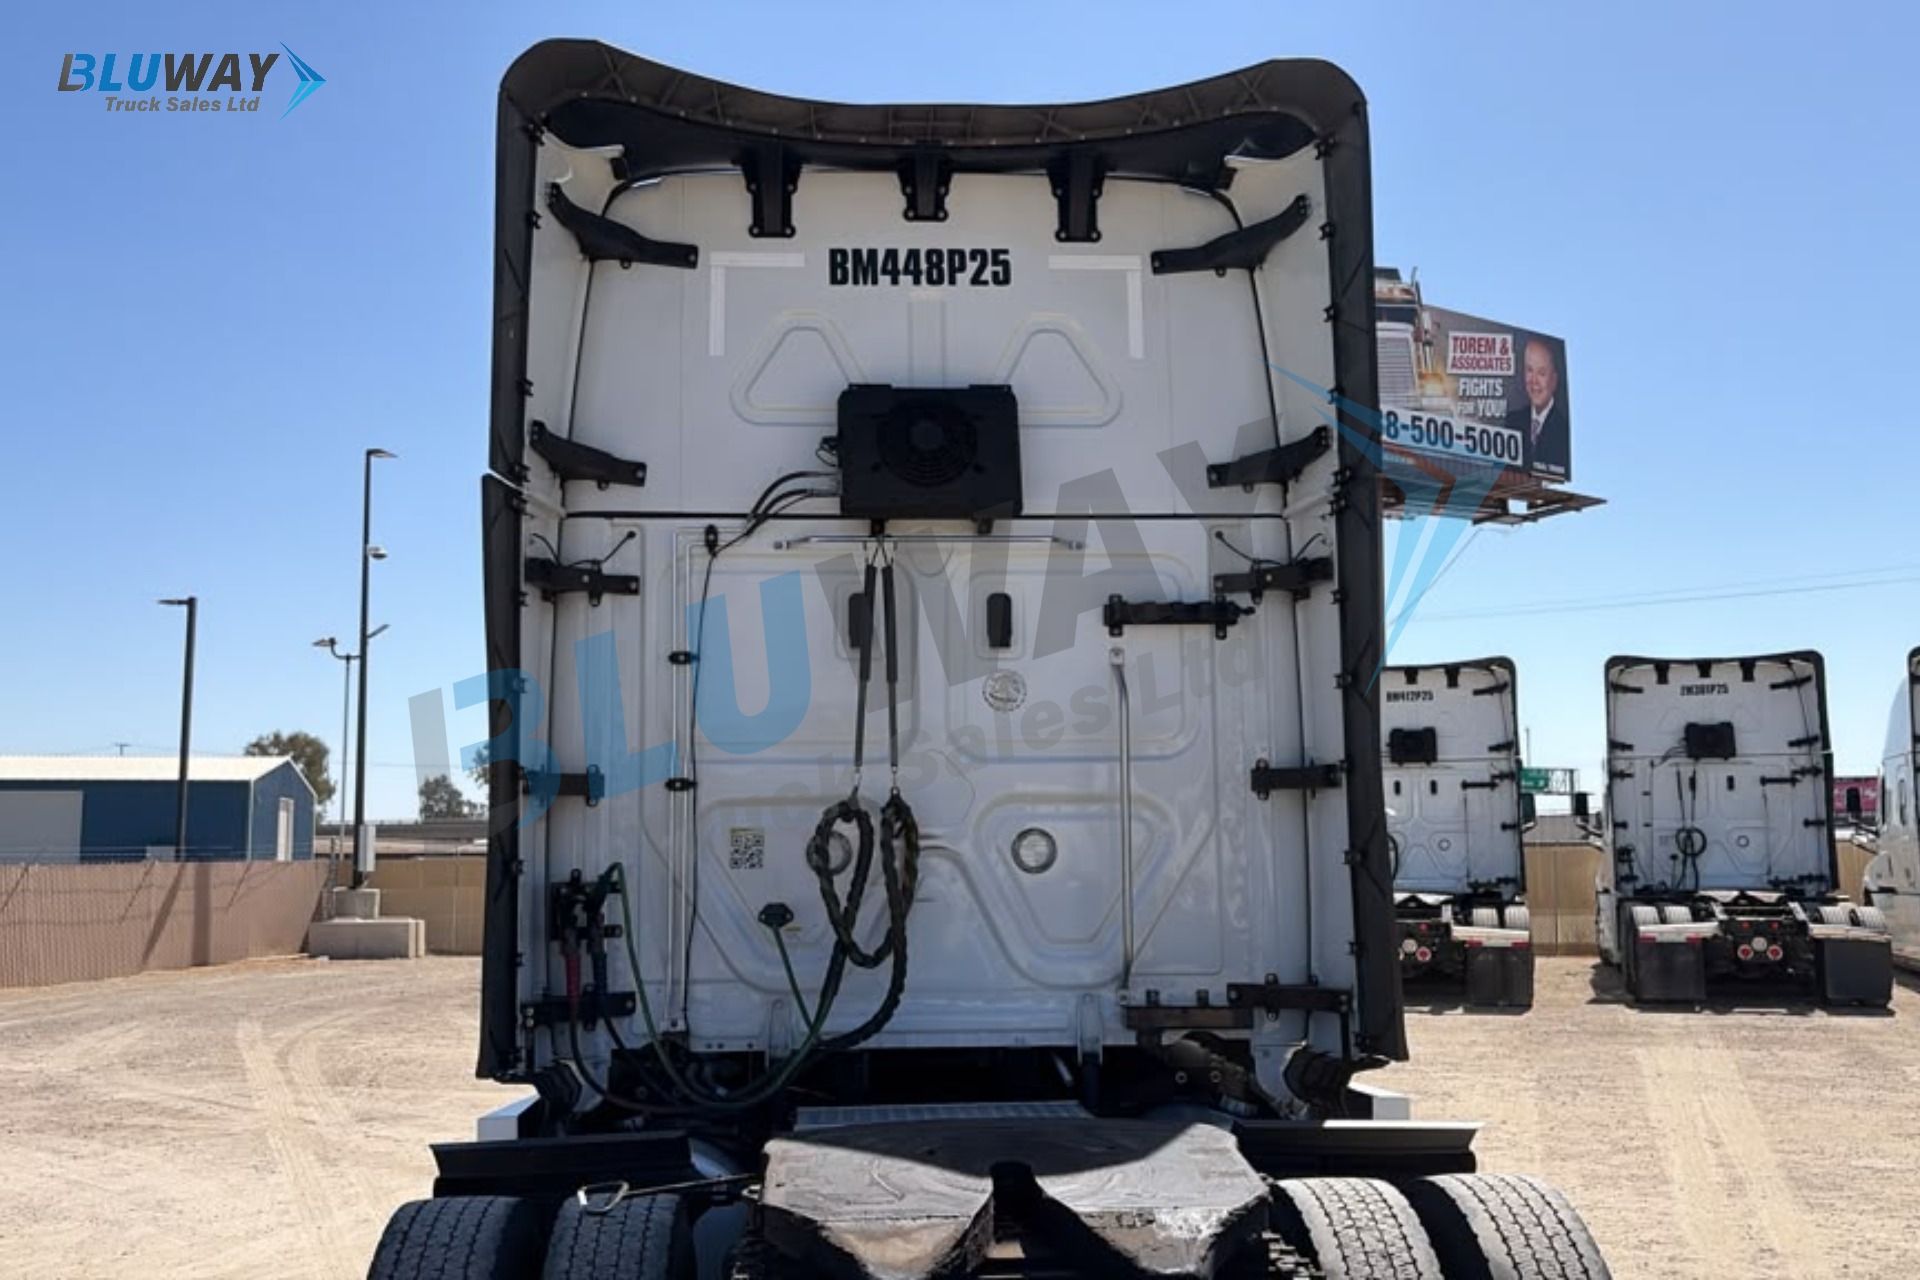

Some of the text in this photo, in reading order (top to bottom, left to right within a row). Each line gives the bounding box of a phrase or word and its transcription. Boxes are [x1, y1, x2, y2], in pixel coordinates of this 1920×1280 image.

[829, 248, 1011, 286] BM448P25
[1452, 336, 1510, 355] TOREM &
[1450, 355, 1512, 372] ASSOCIATES
[1458, 378, 1504, 397] FIGHTS
[1384, 410, 1519, 461] 8-500-5000
